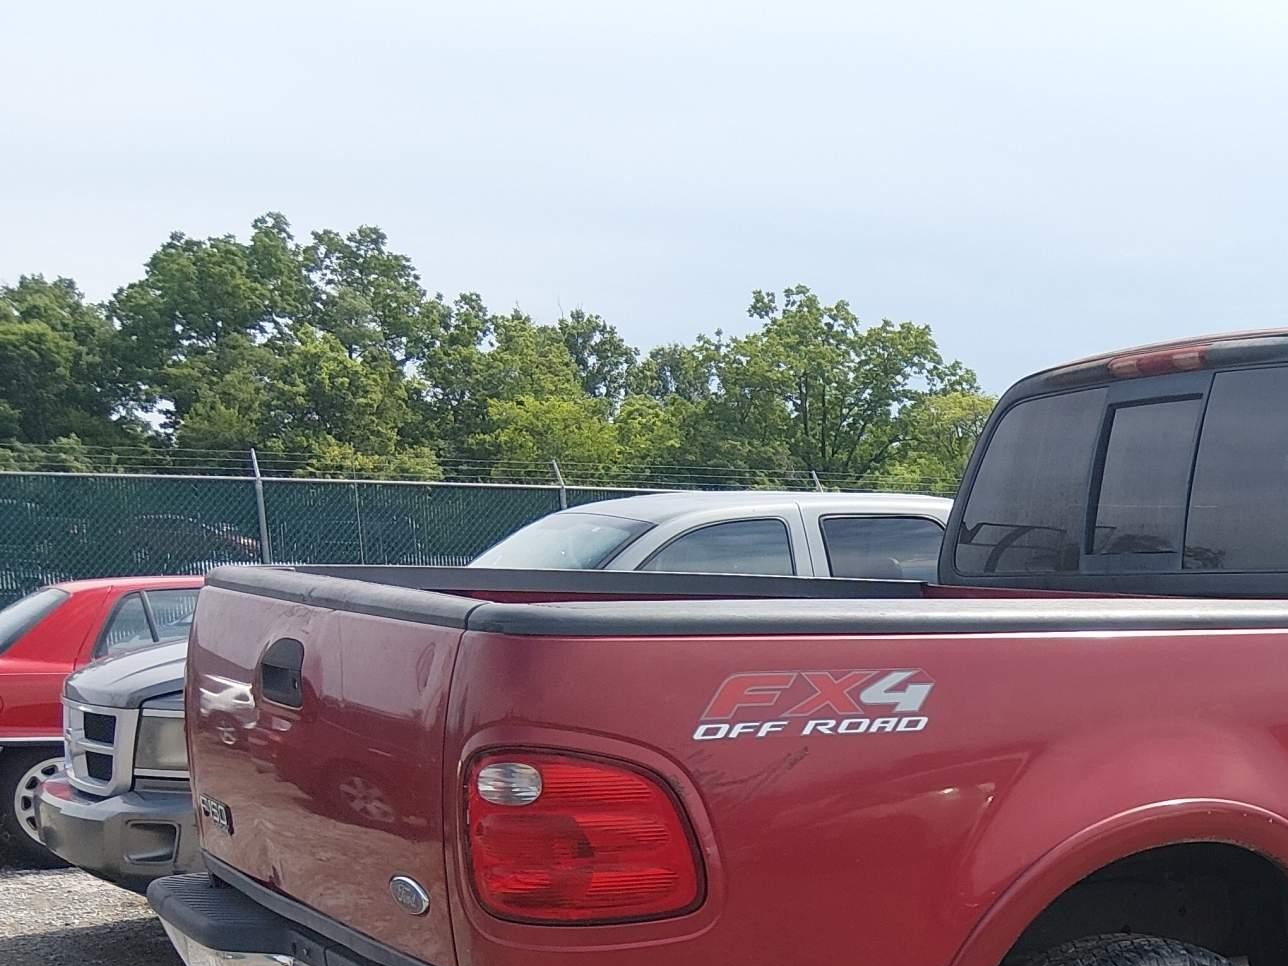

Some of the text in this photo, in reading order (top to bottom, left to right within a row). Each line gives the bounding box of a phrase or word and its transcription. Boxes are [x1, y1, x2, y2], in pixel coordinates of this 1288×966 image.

[700, 669, 935, 720] FX4
[692, 715, 929, 741] OFF ROAD
